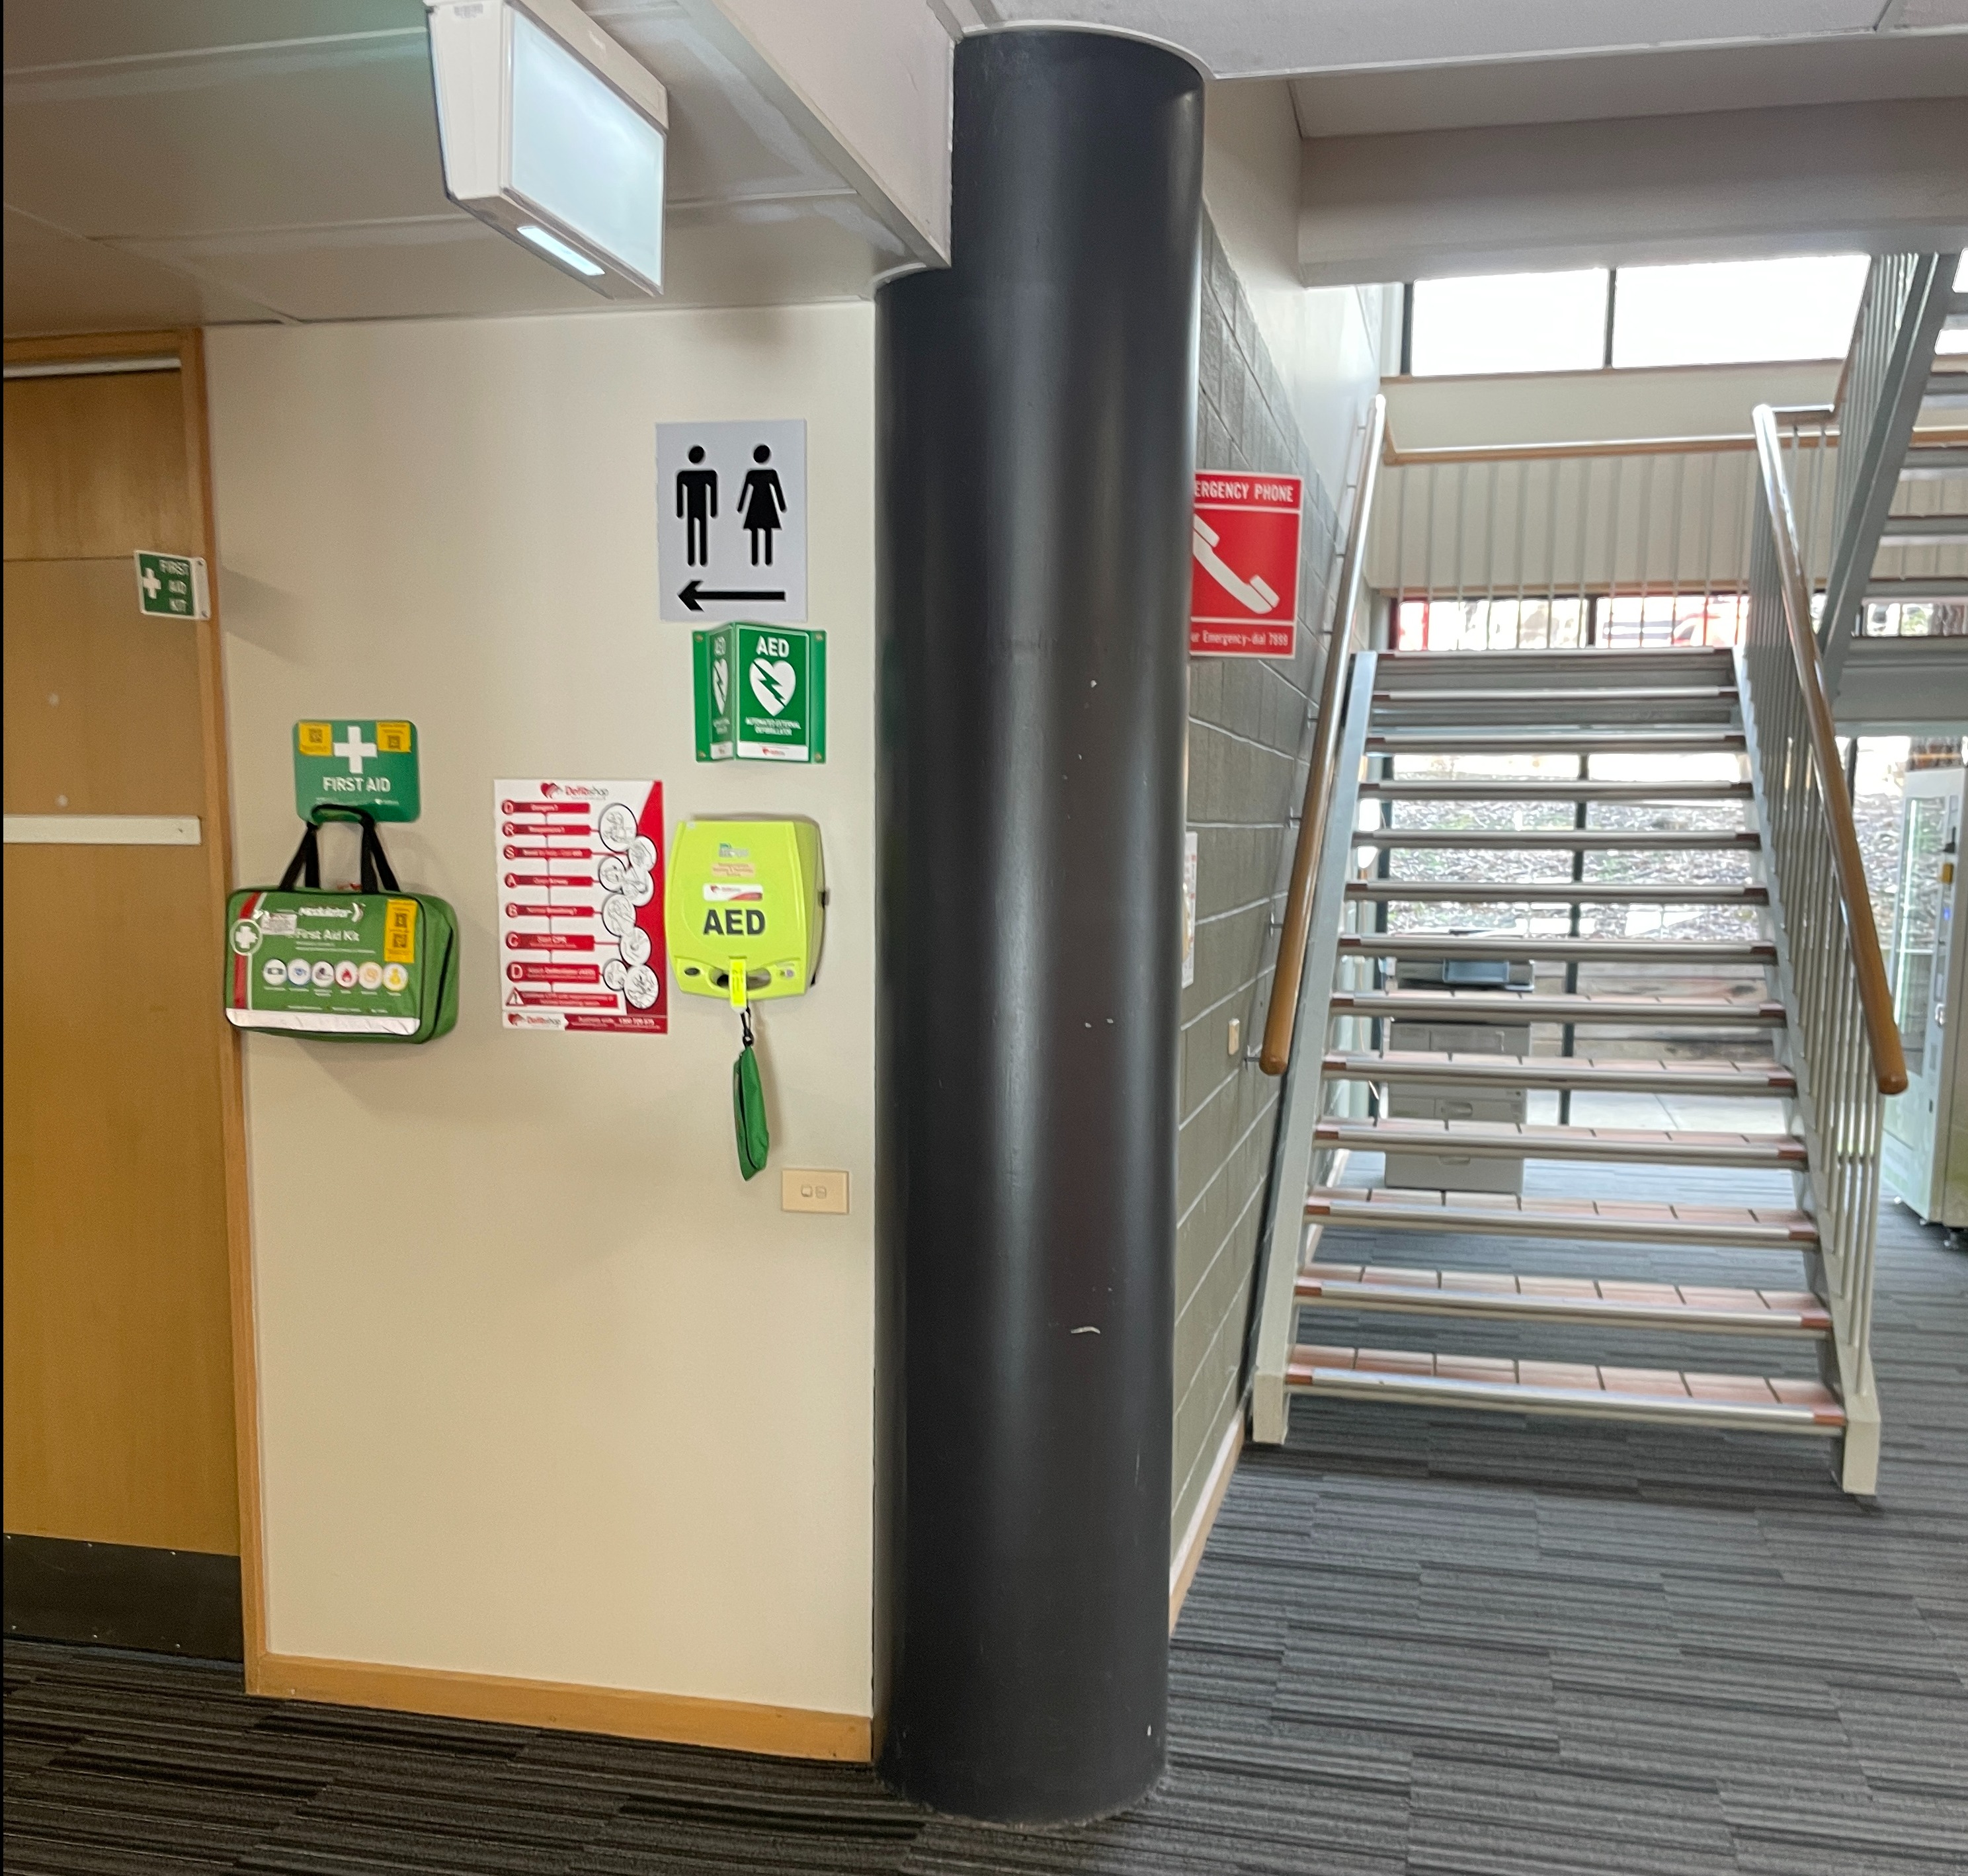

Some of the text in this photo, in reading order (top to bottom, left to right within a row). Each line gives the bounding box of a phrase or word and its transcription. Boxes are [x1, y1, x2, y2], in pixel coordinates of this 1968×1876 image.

[1254, 483, 1294, 503] PHONE
[158, 559, 190, 576] FIRST
[168, 579, 188, 595] AID
[755, 635, 790, 658] AED
[322, 776, 391, 793] FIRST AID
[702, 909, 766, 936] AED
[296, 928, 360, 942] First Aid Kit
[511, 964, 523, 979] D
